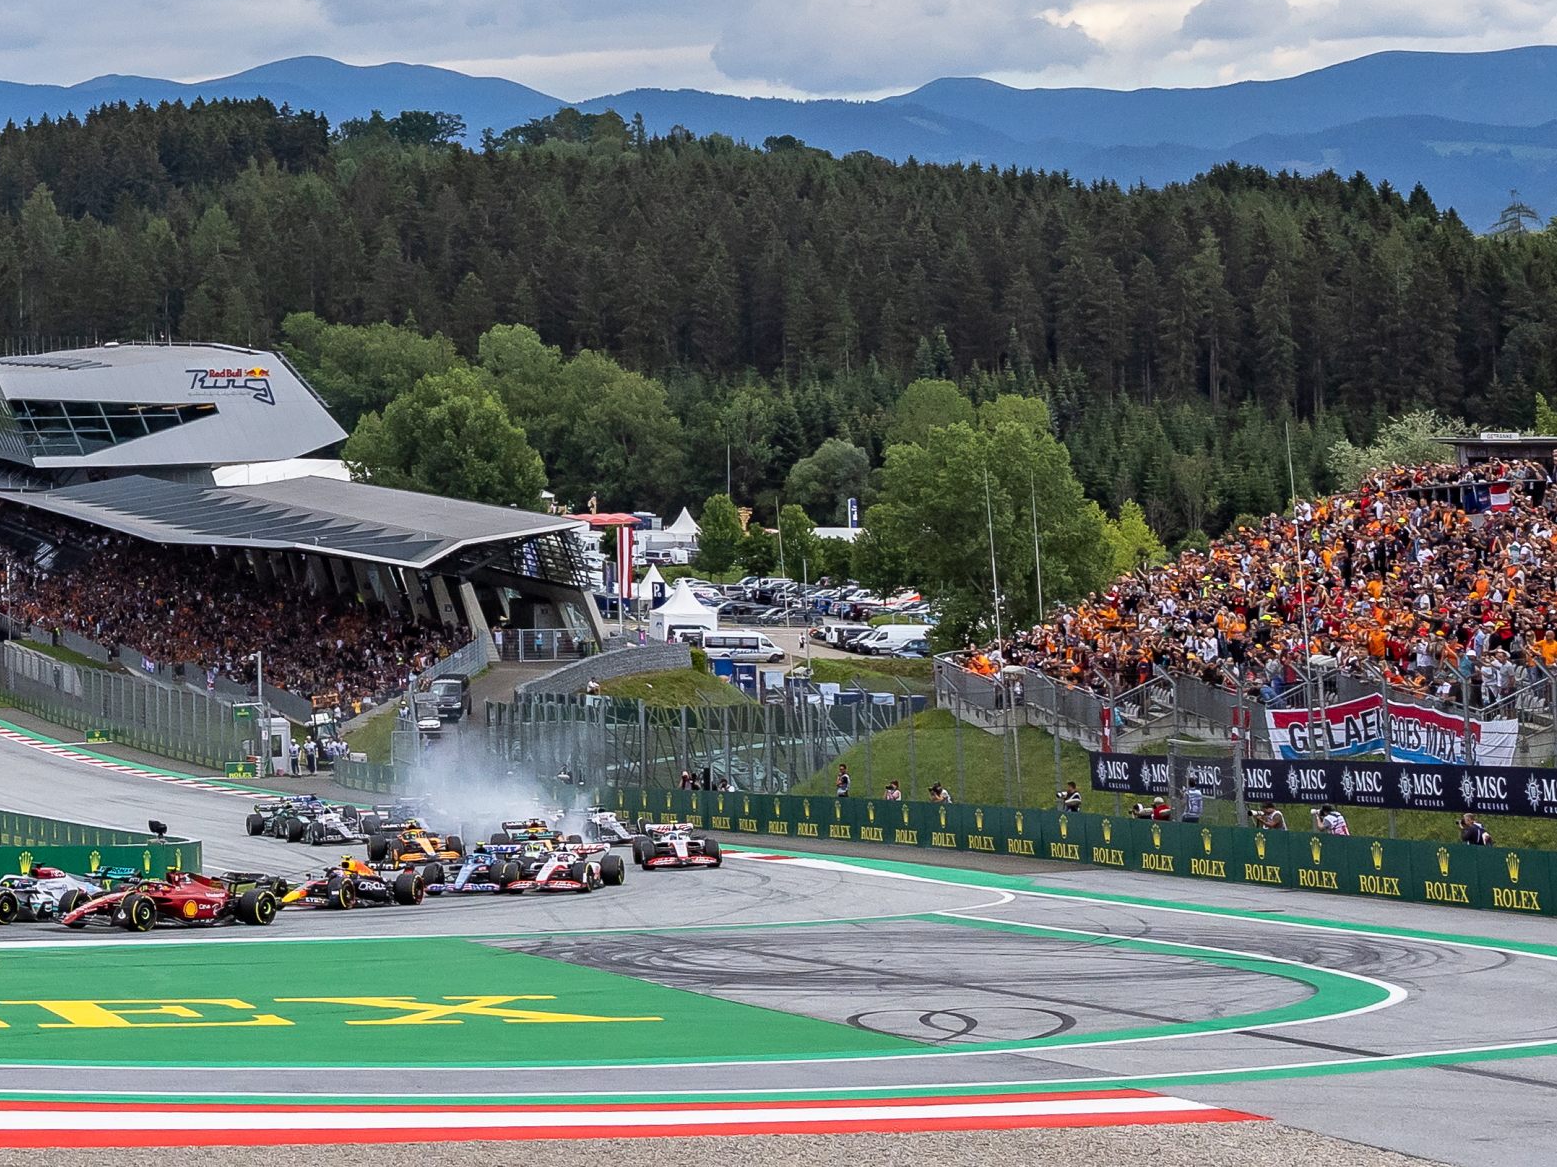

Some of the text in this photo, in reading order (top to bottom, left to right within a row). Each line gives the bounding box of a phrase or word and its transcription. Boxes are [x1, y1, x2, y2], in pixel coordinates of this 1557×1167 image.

[209, 368, 242, 378] Red Bull
[185, 369, 275, 405] Ring
[1389, 714, 1422, 751] GOES
[1425, 722, 1457, 763] MAX
[1106, 760, 1129, 781] MSC
[1246, 768, 1273, 789] MSC
[1299, 769, 1327, 791] MSC
[1354, 770, 1383, 793] MSC
[1412, 773, 1443, 796] MSC
[1475, 775, 1508, 800] MSC
[1414, 798, 1444, 807] CRUISES
[1477, 802, 1509, 811] CRUISES
[712, 816, 731, 830] ROLEX
[739, 818, 758, 832] ROLEX
[768, 820, 788, 835] ROLEX
[797, 822, 819, 837] ROLEX
[829, 824, 852, 839] ROLEX
[860, 826, 883, 841] ROLEX
[895, 829, 918, 844] ROLEX
[932, 831, 957, 847] ROLEX
[968, 835, 995, 851] ROLEX
[1007, 838, 1035, 855] ROLEX
[1050, 842, 1080, 860] ROLEX
[1093, 847, 1124, 866] ROLEX
[1142, 852, 1174, 872] ROLEX
[1191, 858, 1226, 878] ROLEX
[1244, 863, 1282, 883] ROLEX
[358, 881, 387, 890] ORACLE
[1298, 868, 1339, 889] ROLEX
[1358, 874, 1402, 896] ROLEX
[1424, 880, 1470, 903] ROLEX
[1493, 887, 1541, 910] ROLEX
